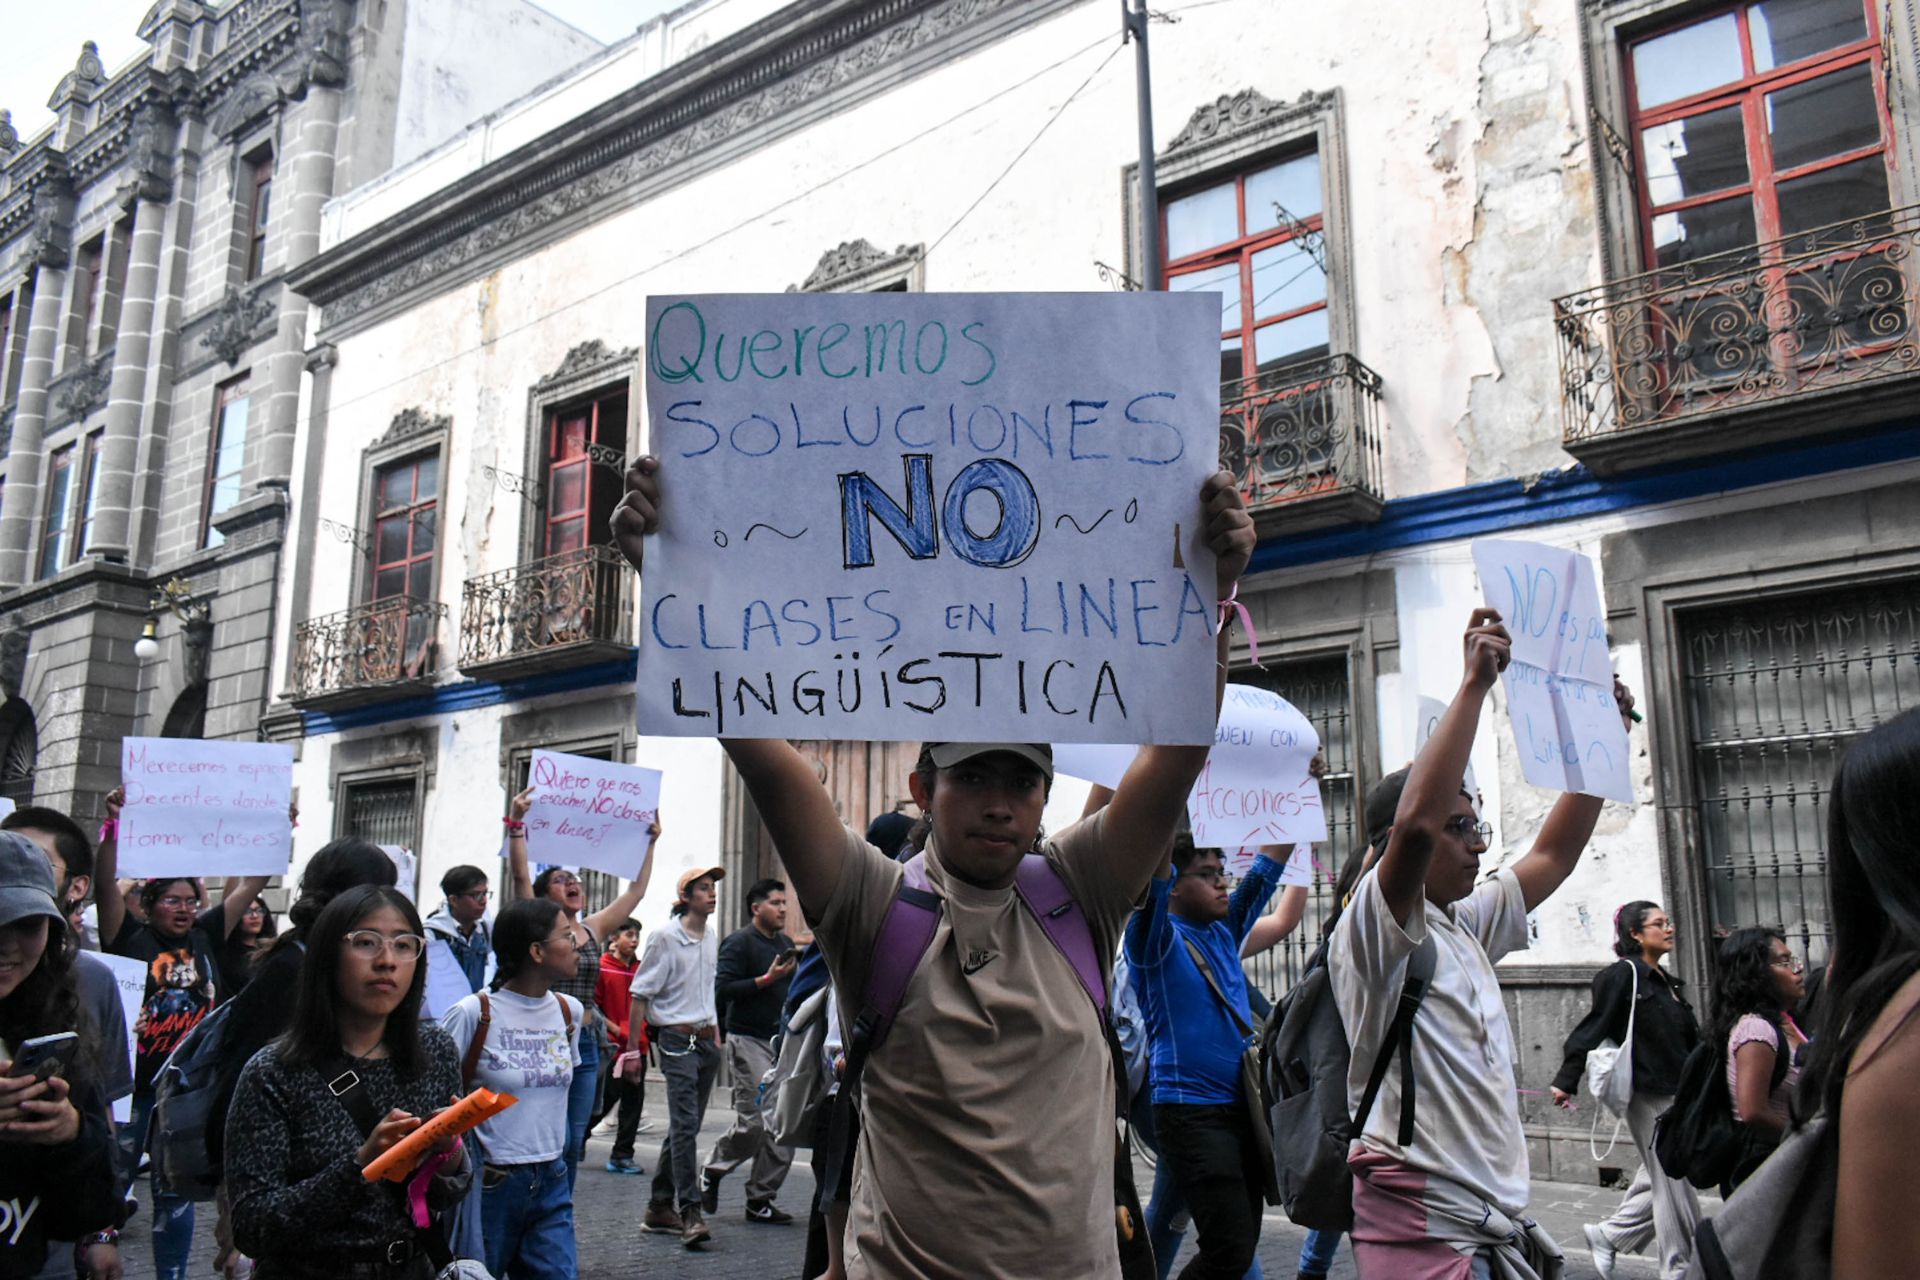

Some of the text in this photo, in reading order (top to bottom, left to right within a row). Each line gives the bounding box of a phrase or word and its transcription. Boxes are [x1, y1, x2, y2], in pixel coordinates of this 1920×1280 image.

[650, 301, 996, 385] Queremos
[666, 392, 1184, 465] SOLUCIONES
[837, 453, 1041, 570] NO
[652, 571, 1213, 650] CLASES EN LINEA
[1504, 563, 1556, 638] NO
[672, 645, 1127, 734] LINGÜÍSTICA
[1271, 729, 1298, 748] CON
[129, 745, 227, 774] Merecemos
[535, 756, 642, 798] Quiero que nos
[233, 790, 278, 807] donde
[585, 796, 615, 815] NO
[123, 818, 280, 849] tomar clases
[531, 818, 550, 830] en
[968, 950, 989, 966] NIKE
[499, 1033, 548, 1055] Happy
[508, 1051, 547, 1070] Safe
[523, 1069, 570, 1088] Place
